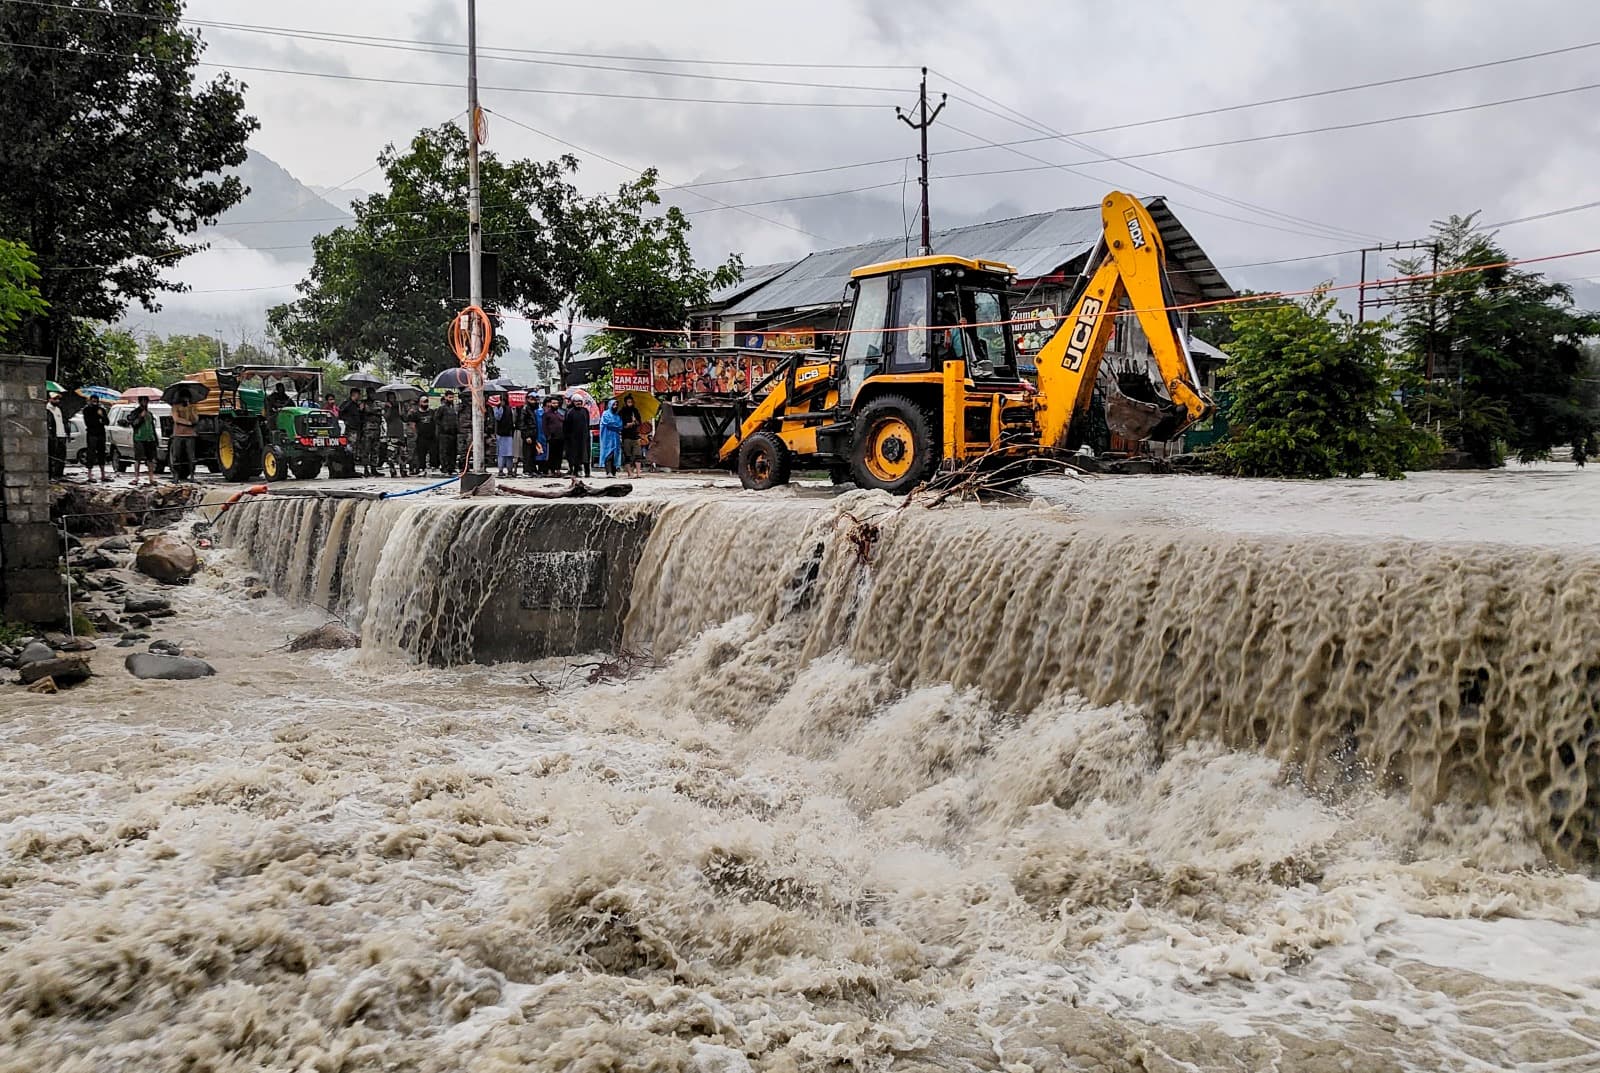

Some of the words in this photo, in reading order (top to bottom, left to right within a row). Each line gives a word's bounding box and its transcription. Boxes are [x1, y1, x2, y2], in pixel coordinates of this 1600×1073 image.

[1062, 298, 1101, 370] JCB
[615, 376, 631, 384] ZAM
[632, 376, 649, 385] ZAM
[799, 369, 818, 381] JCB
